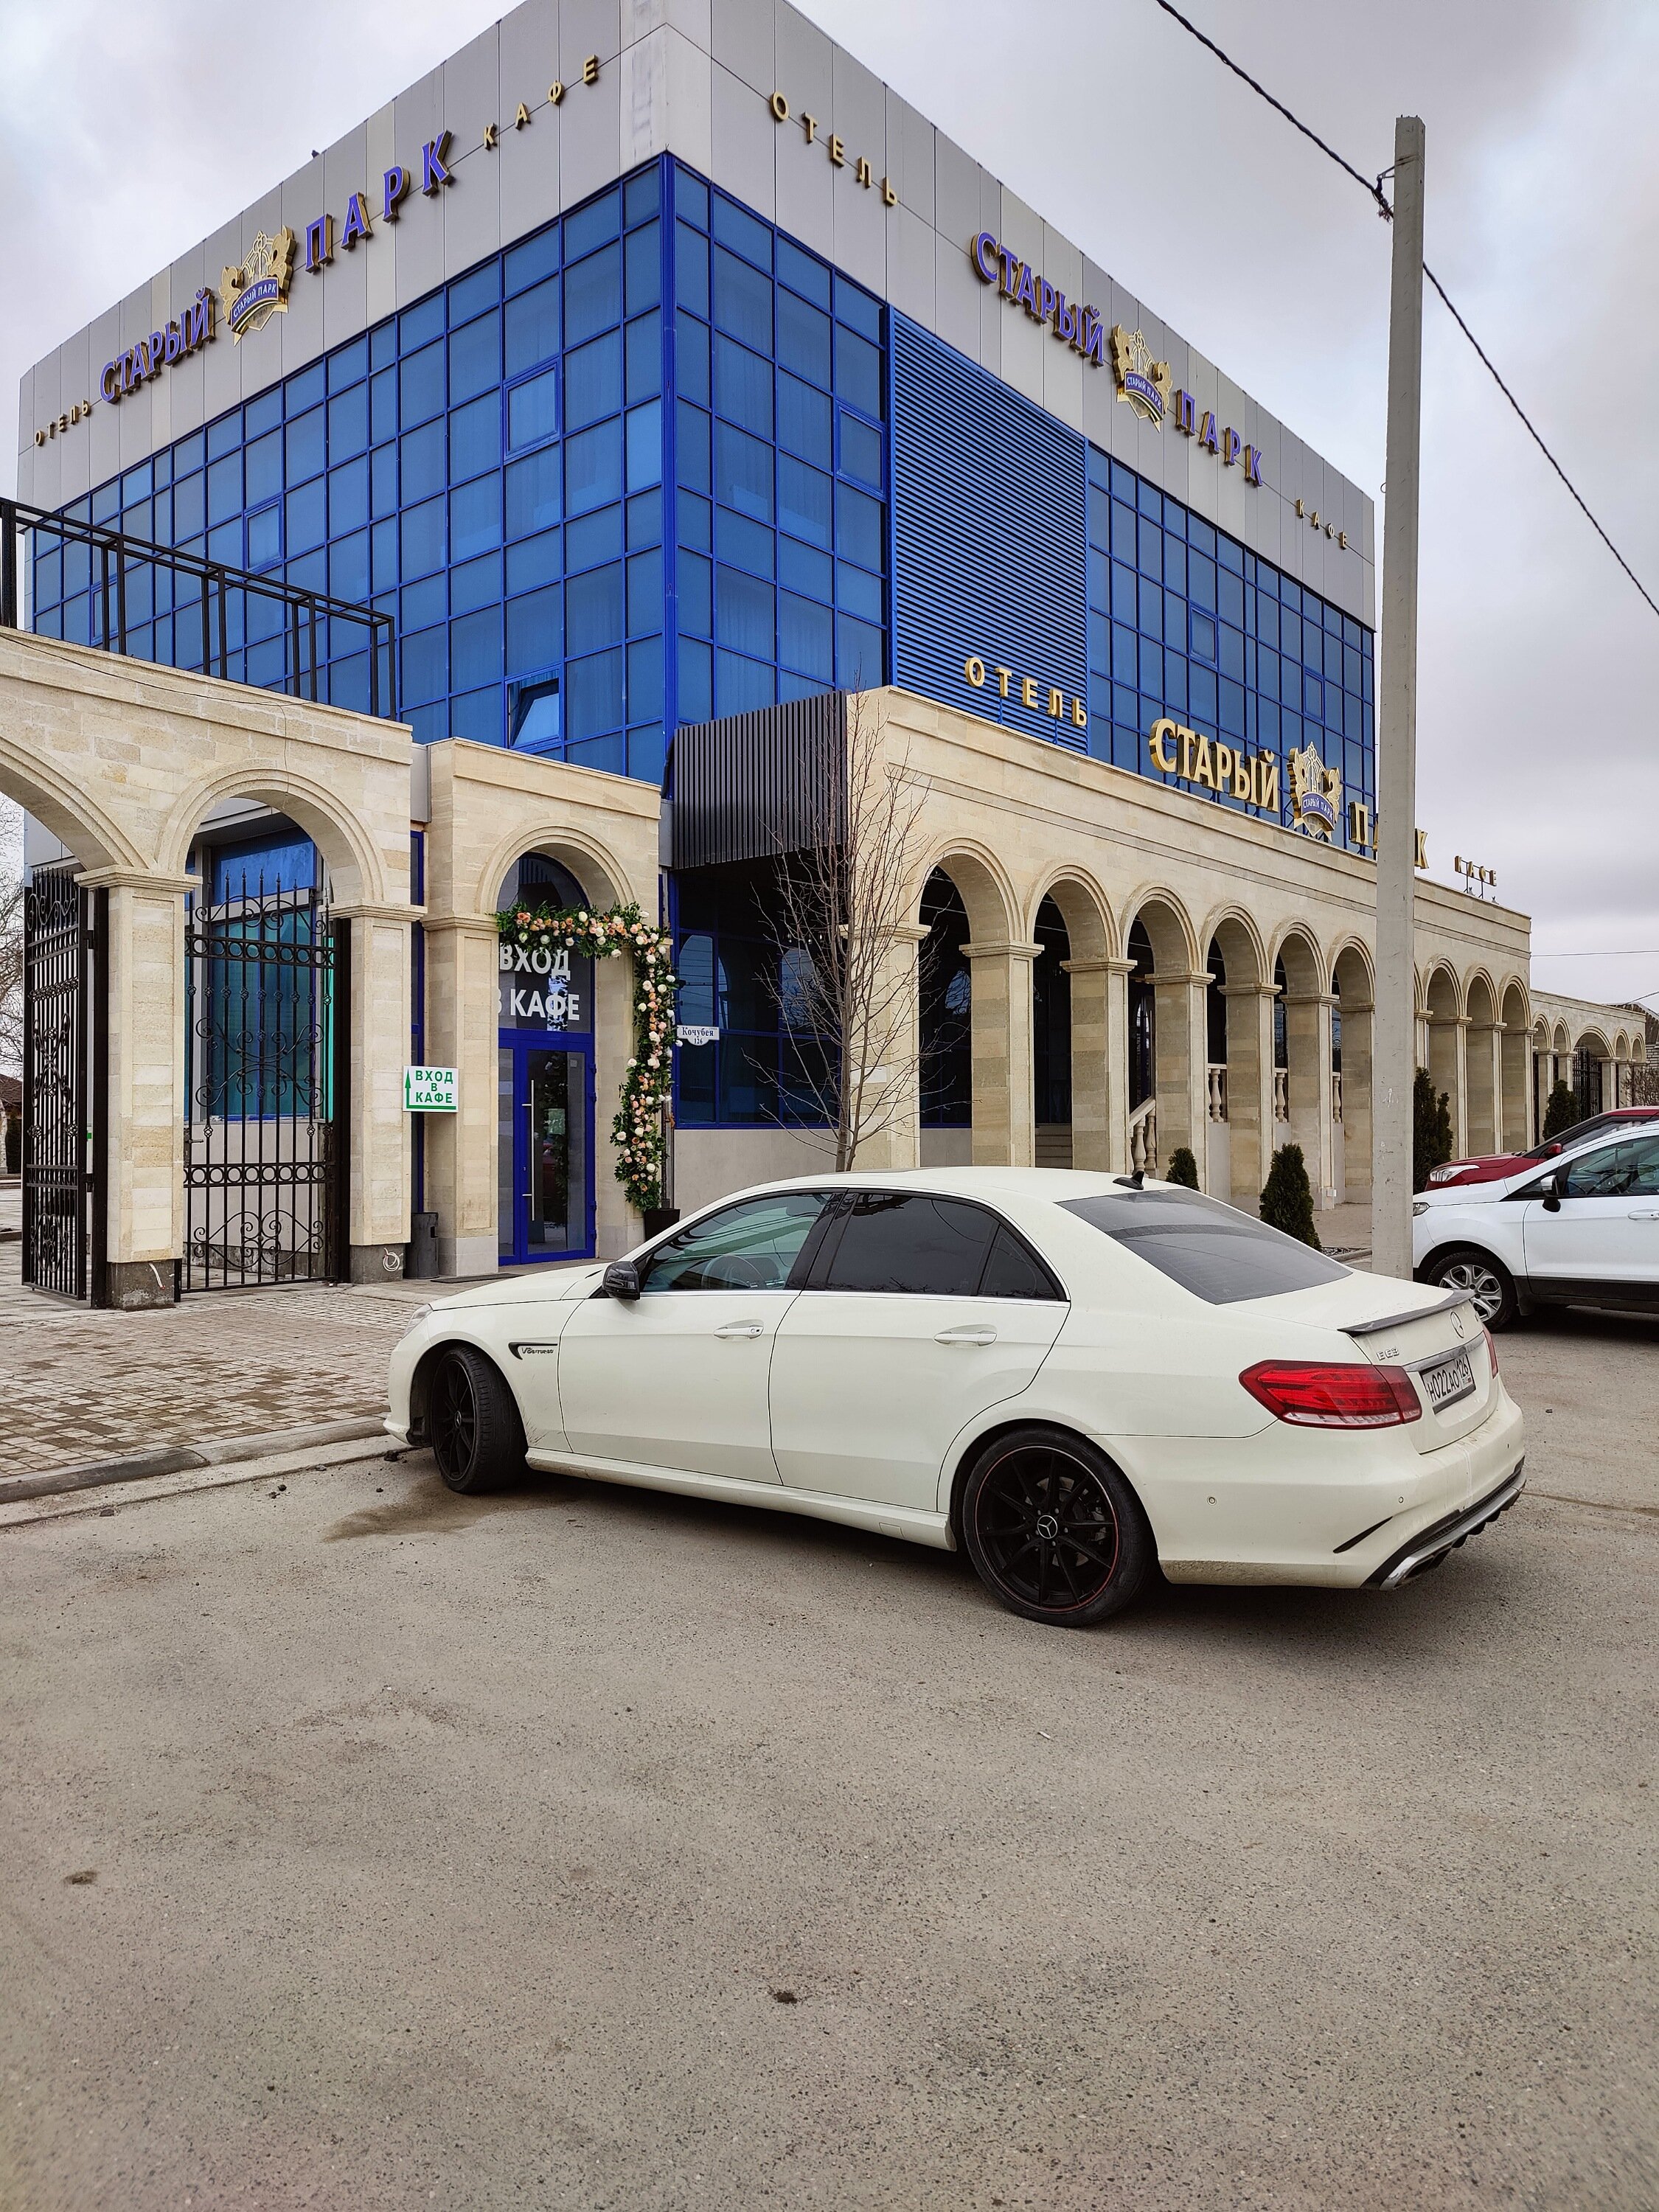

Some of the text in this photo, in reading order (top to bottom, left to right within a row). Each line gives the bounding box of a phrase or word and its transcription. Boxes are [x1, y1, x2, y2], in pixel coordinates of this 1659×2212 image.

[35, 55, 599, 447] ОТЕЛЬ СТАРЫЙ ПАРК КАФЕ
[233, 288, 257, 318] СТАРЫЙ
[258, 283, 276, 296] ПАРК
[770, 91, 1348, 550] ОТЕЛЬ СТАРЫЙ ПАРК КАФЕ
[1127, 376, 1146, 392] СТАРЫЙ
[1147, 386, 1162, 409] ПАРК
[964, 657, 1498, 887] ОТЕЛЬ СТАРЫЙ ПК КАФЕ
[1303, 798, 1333, 820] СТАРЫЙ ПАРК
[500, 943, 571, 981] ВХОД
[510, 988, 580, 1020] КАФЕ
[682, 1027, 714, 1037] Кочубея
[415, 1070, 453, 1084] ВХОД
[431, 1082, 437, 1091] В
[415, 1092, 453, 1103] КАФЕ
[1456, 1357, 1469, 1378] 126
